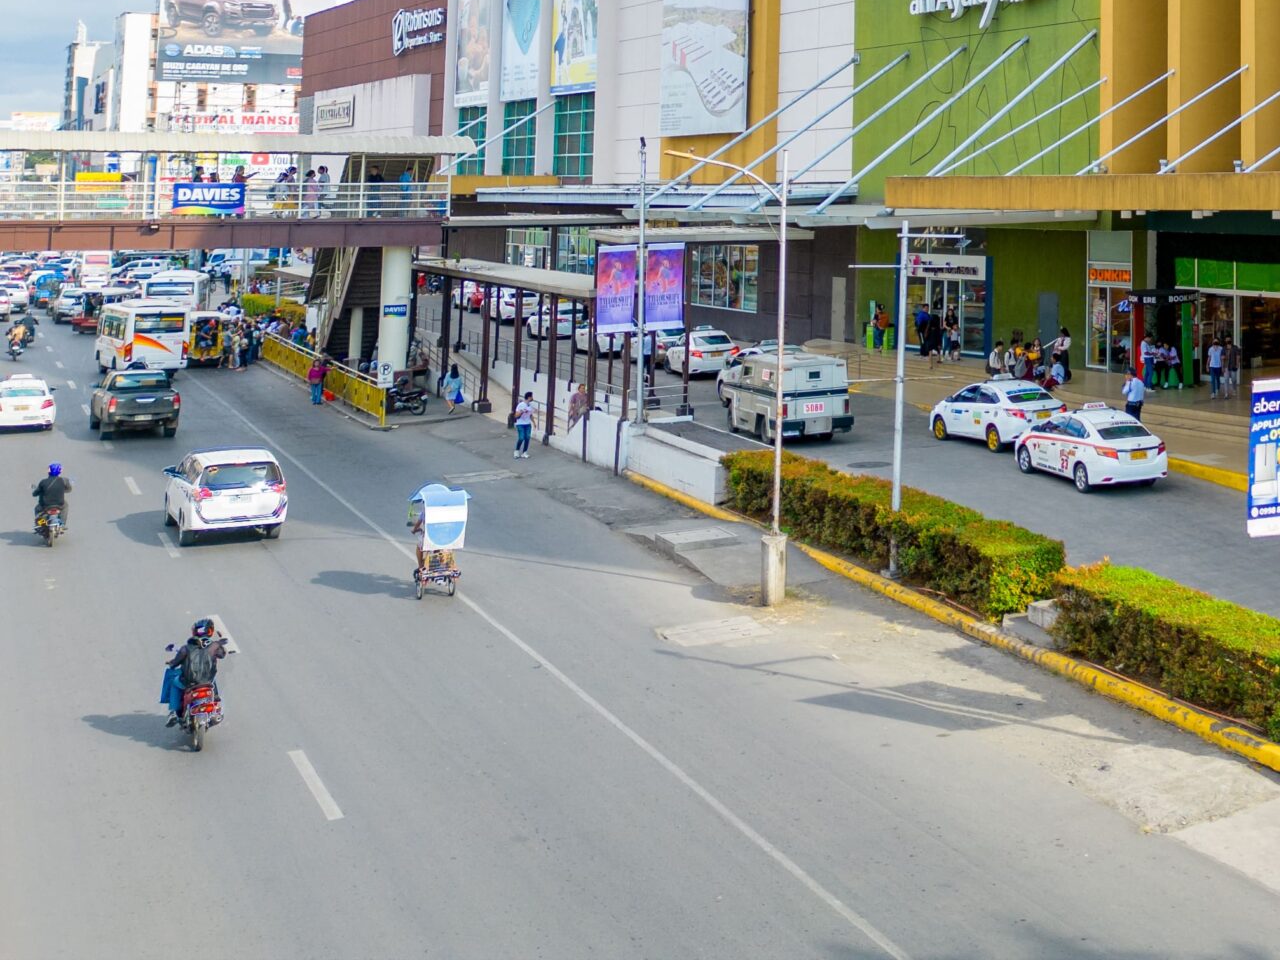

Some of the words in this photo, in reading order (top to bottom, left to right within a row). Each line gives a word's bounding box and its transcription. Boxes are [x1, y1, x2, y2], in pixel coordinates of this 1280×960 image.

[405, 7, 444, 32] Robinsons
[183, 44, 225, 56] ADAS
[177, 187, 241, 201] DAVIES
[1088, 268, 1131, 283] DUNKIN
